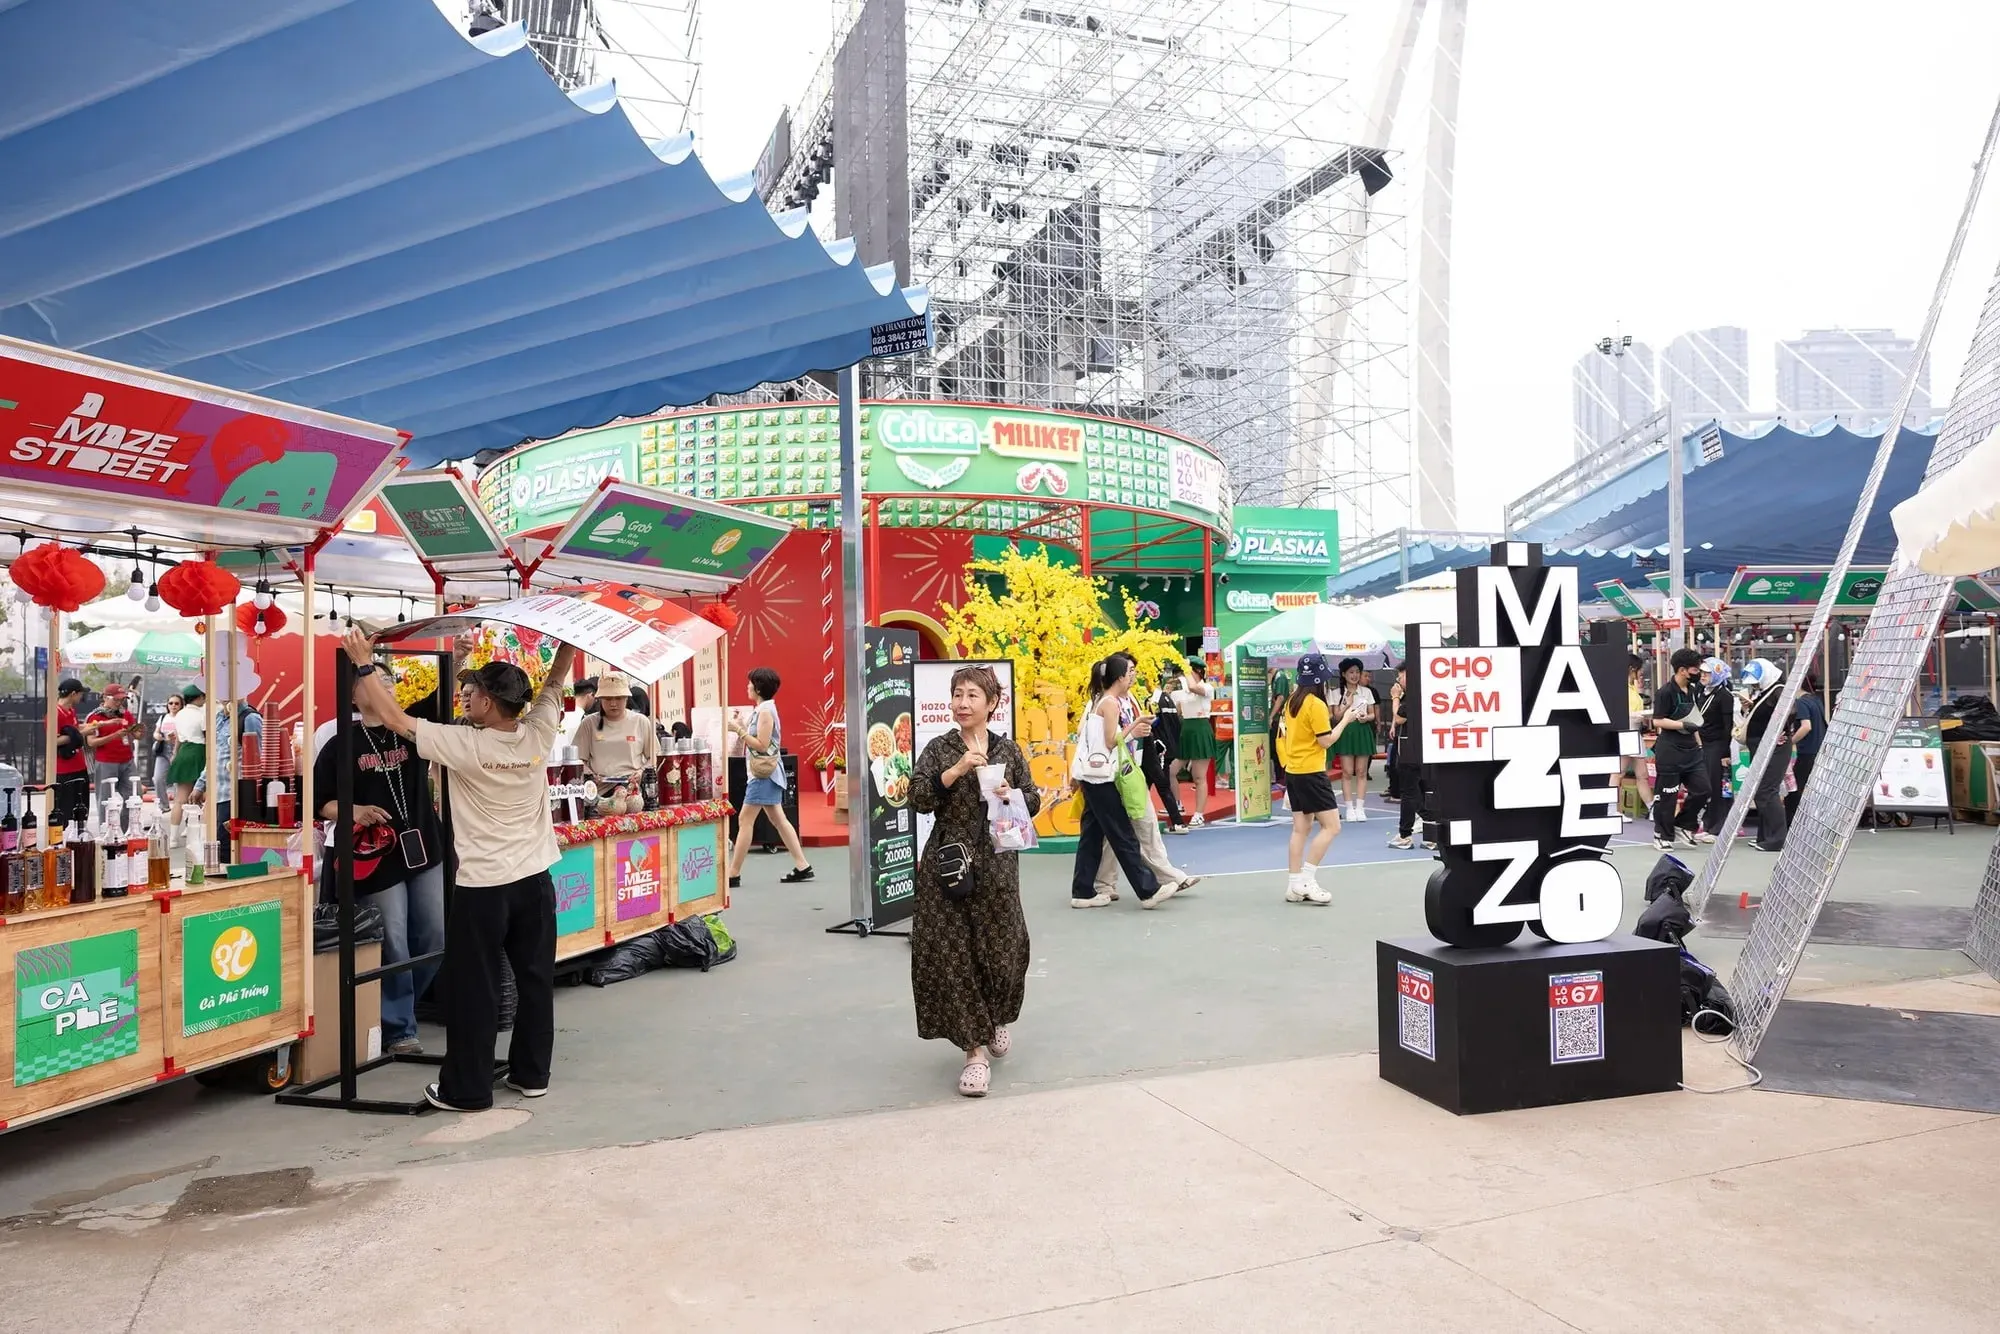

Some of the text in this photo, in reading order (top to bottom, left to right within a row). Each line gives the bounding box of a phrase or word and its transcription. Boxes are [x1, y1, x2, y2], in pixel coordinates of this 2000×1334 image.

[872, 328, 926, 345] 028 3842 7947
[872, 338, 927, 355] 0937 113 234
[54, 416, 179, 457] MAZE
[883, 414, 975, 444] Colusa
[993, 421, 1081, 452] MILIKET
[9, 437, 189, 483] STREET
[534, 459, 626, 499] PLASMA
[1179, 488, 1203, 505] 2025
[1244, 536, 1329, 557] PLASMA
[146, 653, 184, 665] PLASMA
[1430, 655, 1492, 680] CHỢ
[921, 702, 946, 711] HOZO
[1431, 684, 1500, 714] SẮM
[921, 714, 951, 723] GONG
[1432, 718, 1489, 749] TẾT
[624, 869, 653, 886] MAZE
[618, 880, 659, 901] STREET
[40, 976, 90, 1011] CÀ
[199, 995, 215, 1010] Cà
[218, 989, 239, 1006] Phê
[1410, 978, 1430, 1000] 70
[1555, 985, 1568, 996] LÔ
[1555, 994, 1568, 1005] TÔ
[1571, 984, 1599, 1004] 67
